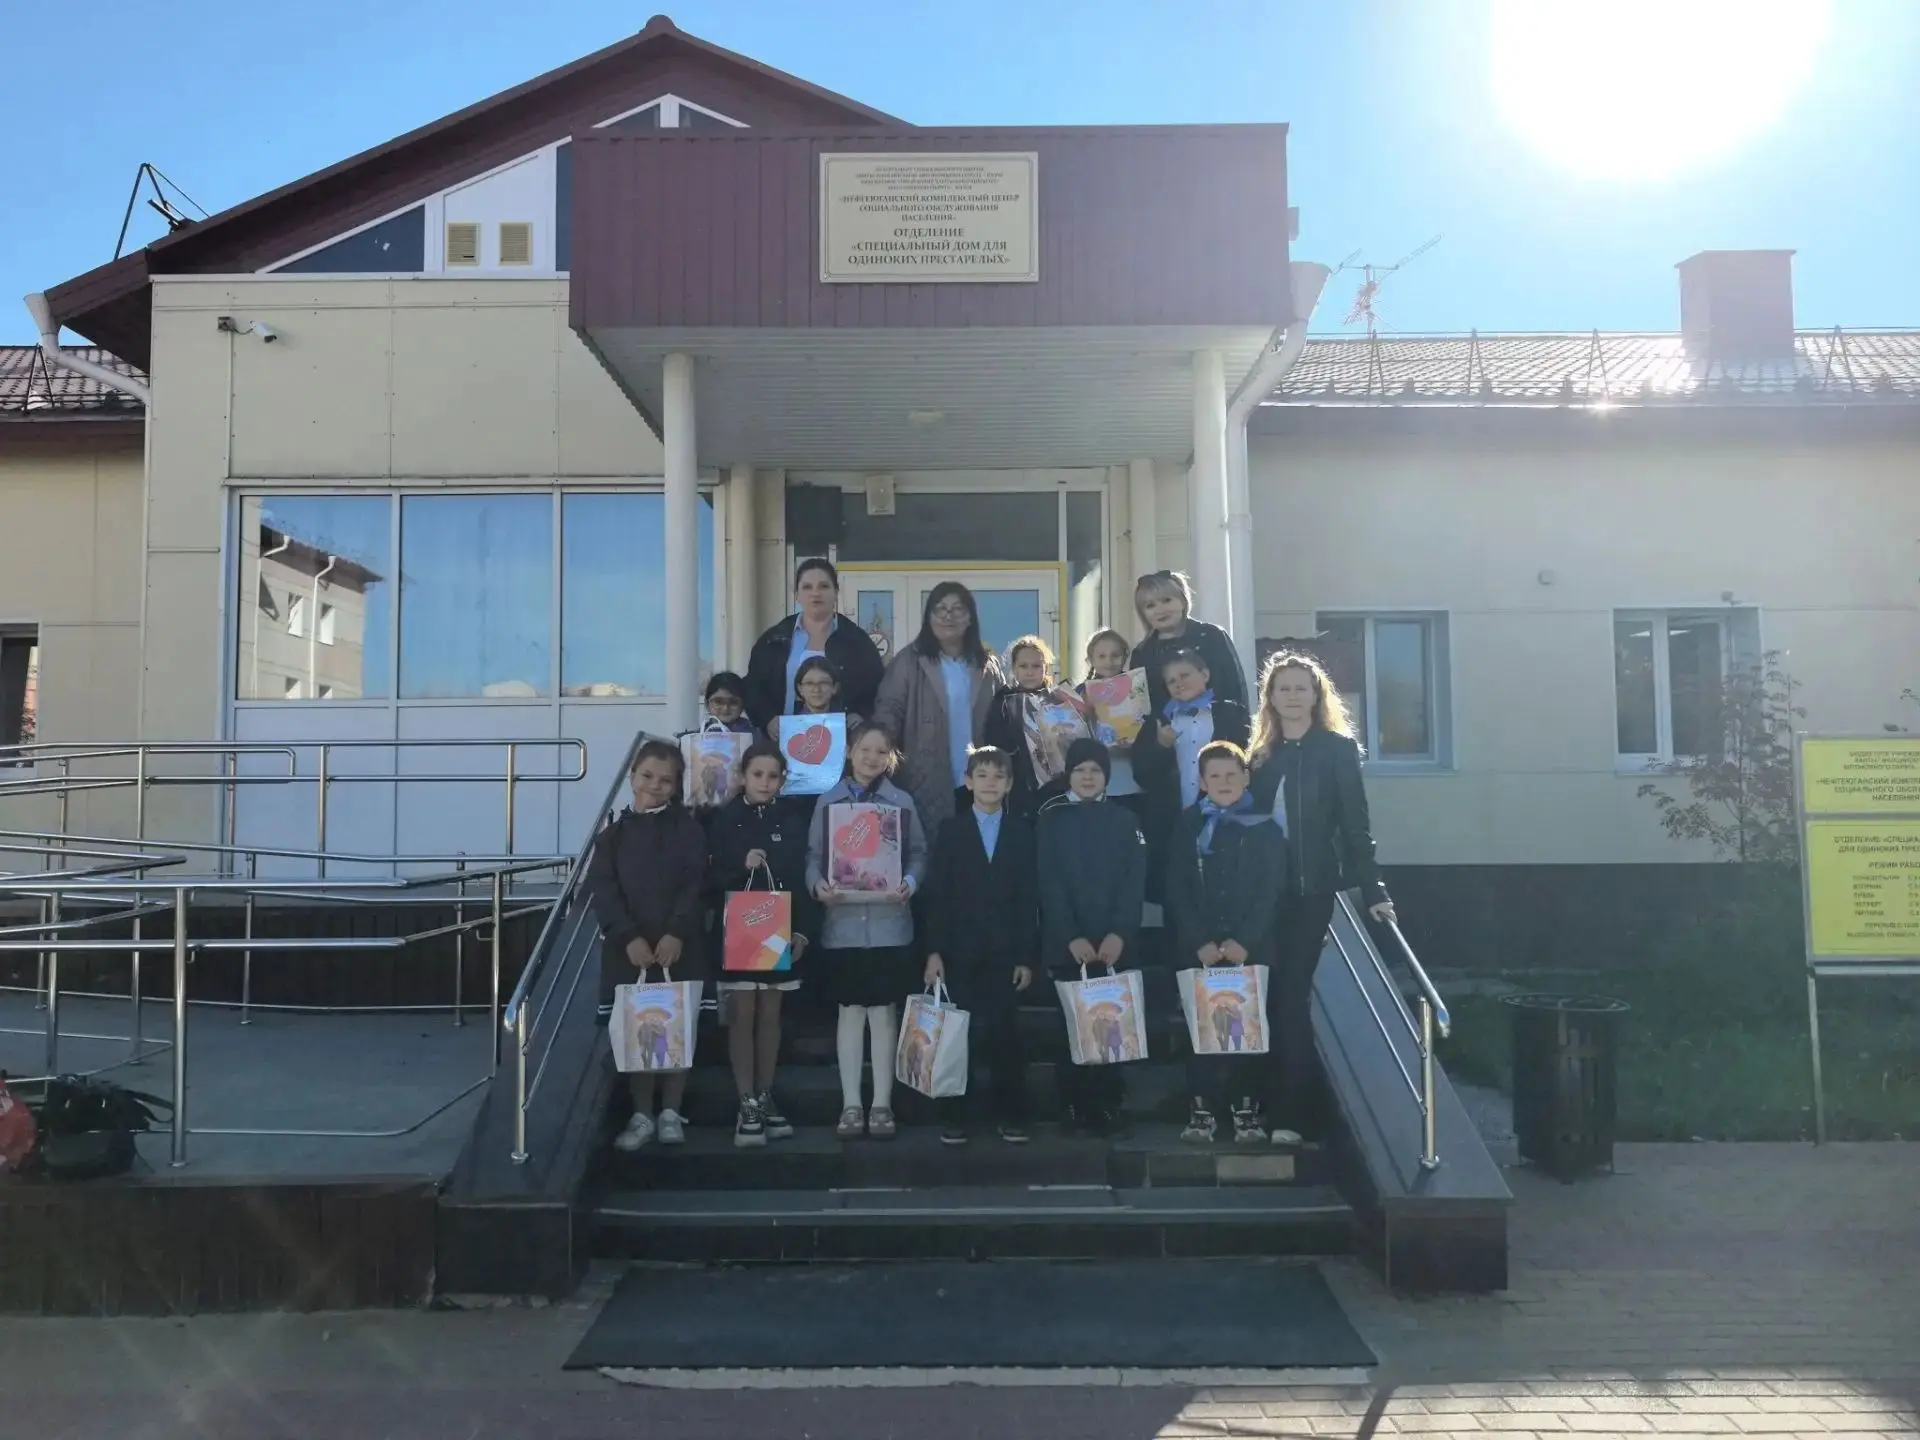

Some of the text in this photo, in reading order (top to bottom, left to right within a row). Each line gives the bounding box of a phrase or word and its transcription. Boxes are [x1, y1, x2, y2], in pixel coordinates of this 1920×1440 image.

[893, 228, 965, 239] ОТДЕЛЕНИЕ
[851, 239, 1007, 252] «СПЕЦИАЛЬНЫЙ ДОМ ДЛЯ
[848, 255, 1011, 267] ОДИНОКИХ ПРЕСТАРЕЛЫХ»
